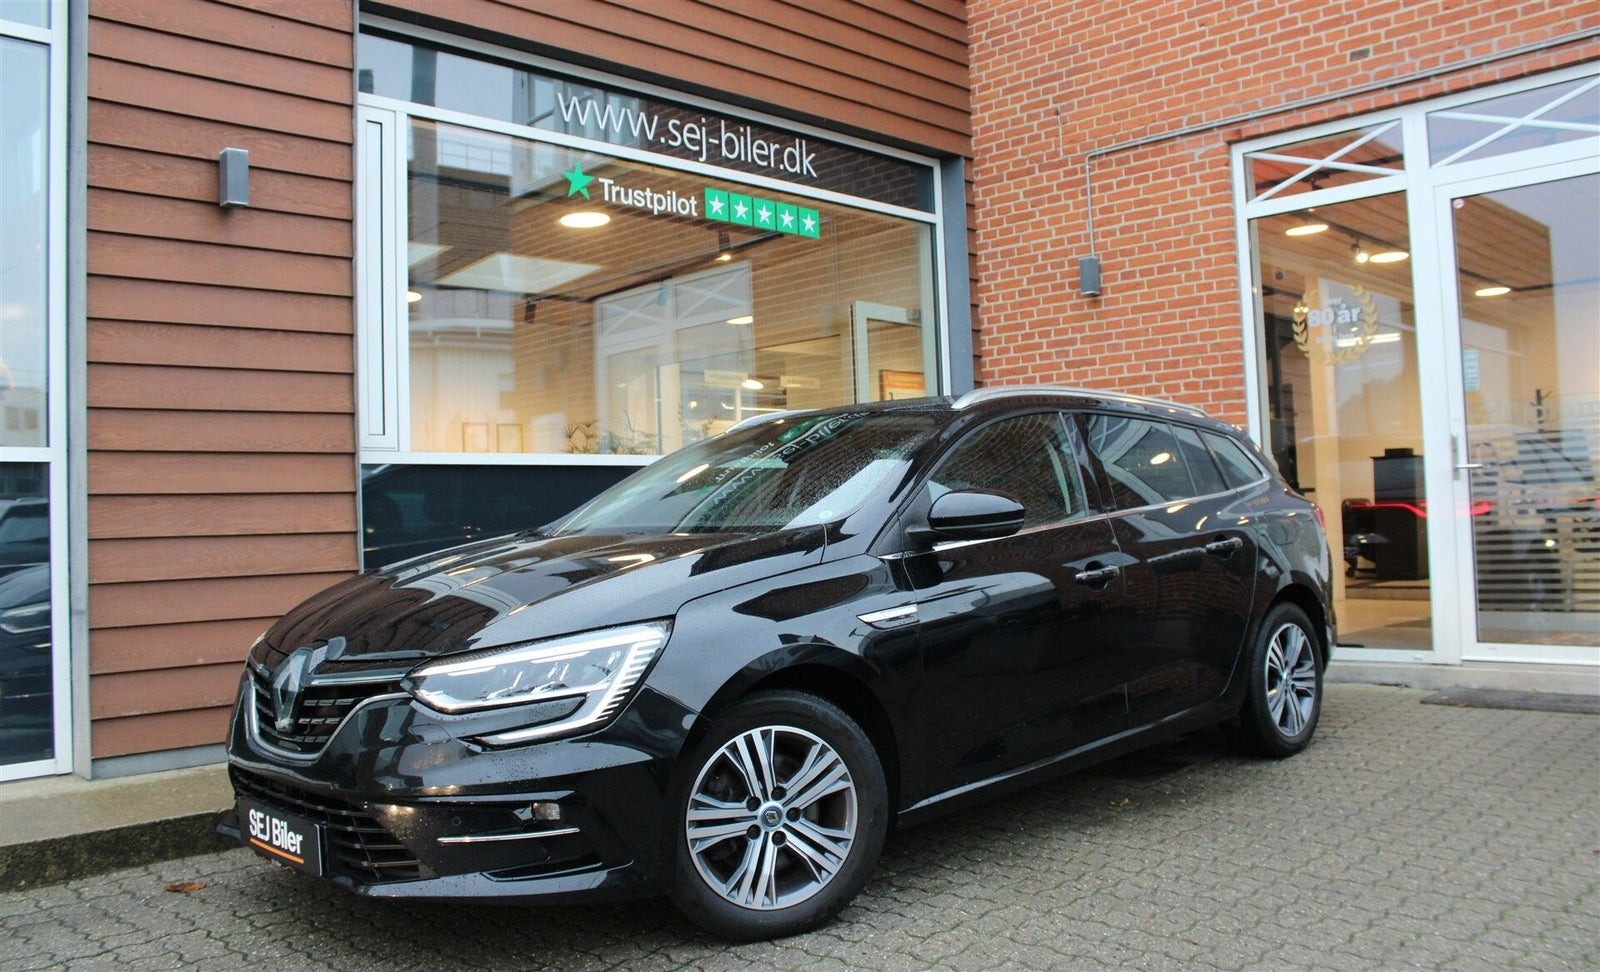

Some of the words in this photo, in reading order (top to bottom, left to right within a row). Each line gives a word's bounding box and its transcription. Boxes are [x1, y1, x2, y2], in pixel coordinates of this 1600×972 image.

[557, 92, 818, 177] www.sej-biler.dk
[598, 178, 698, 216] Trustpilot
[1337, 303, 1361, 323] år
[249, 808, 270, 841] SEJ
[271, 817, 304, 854] Biler
